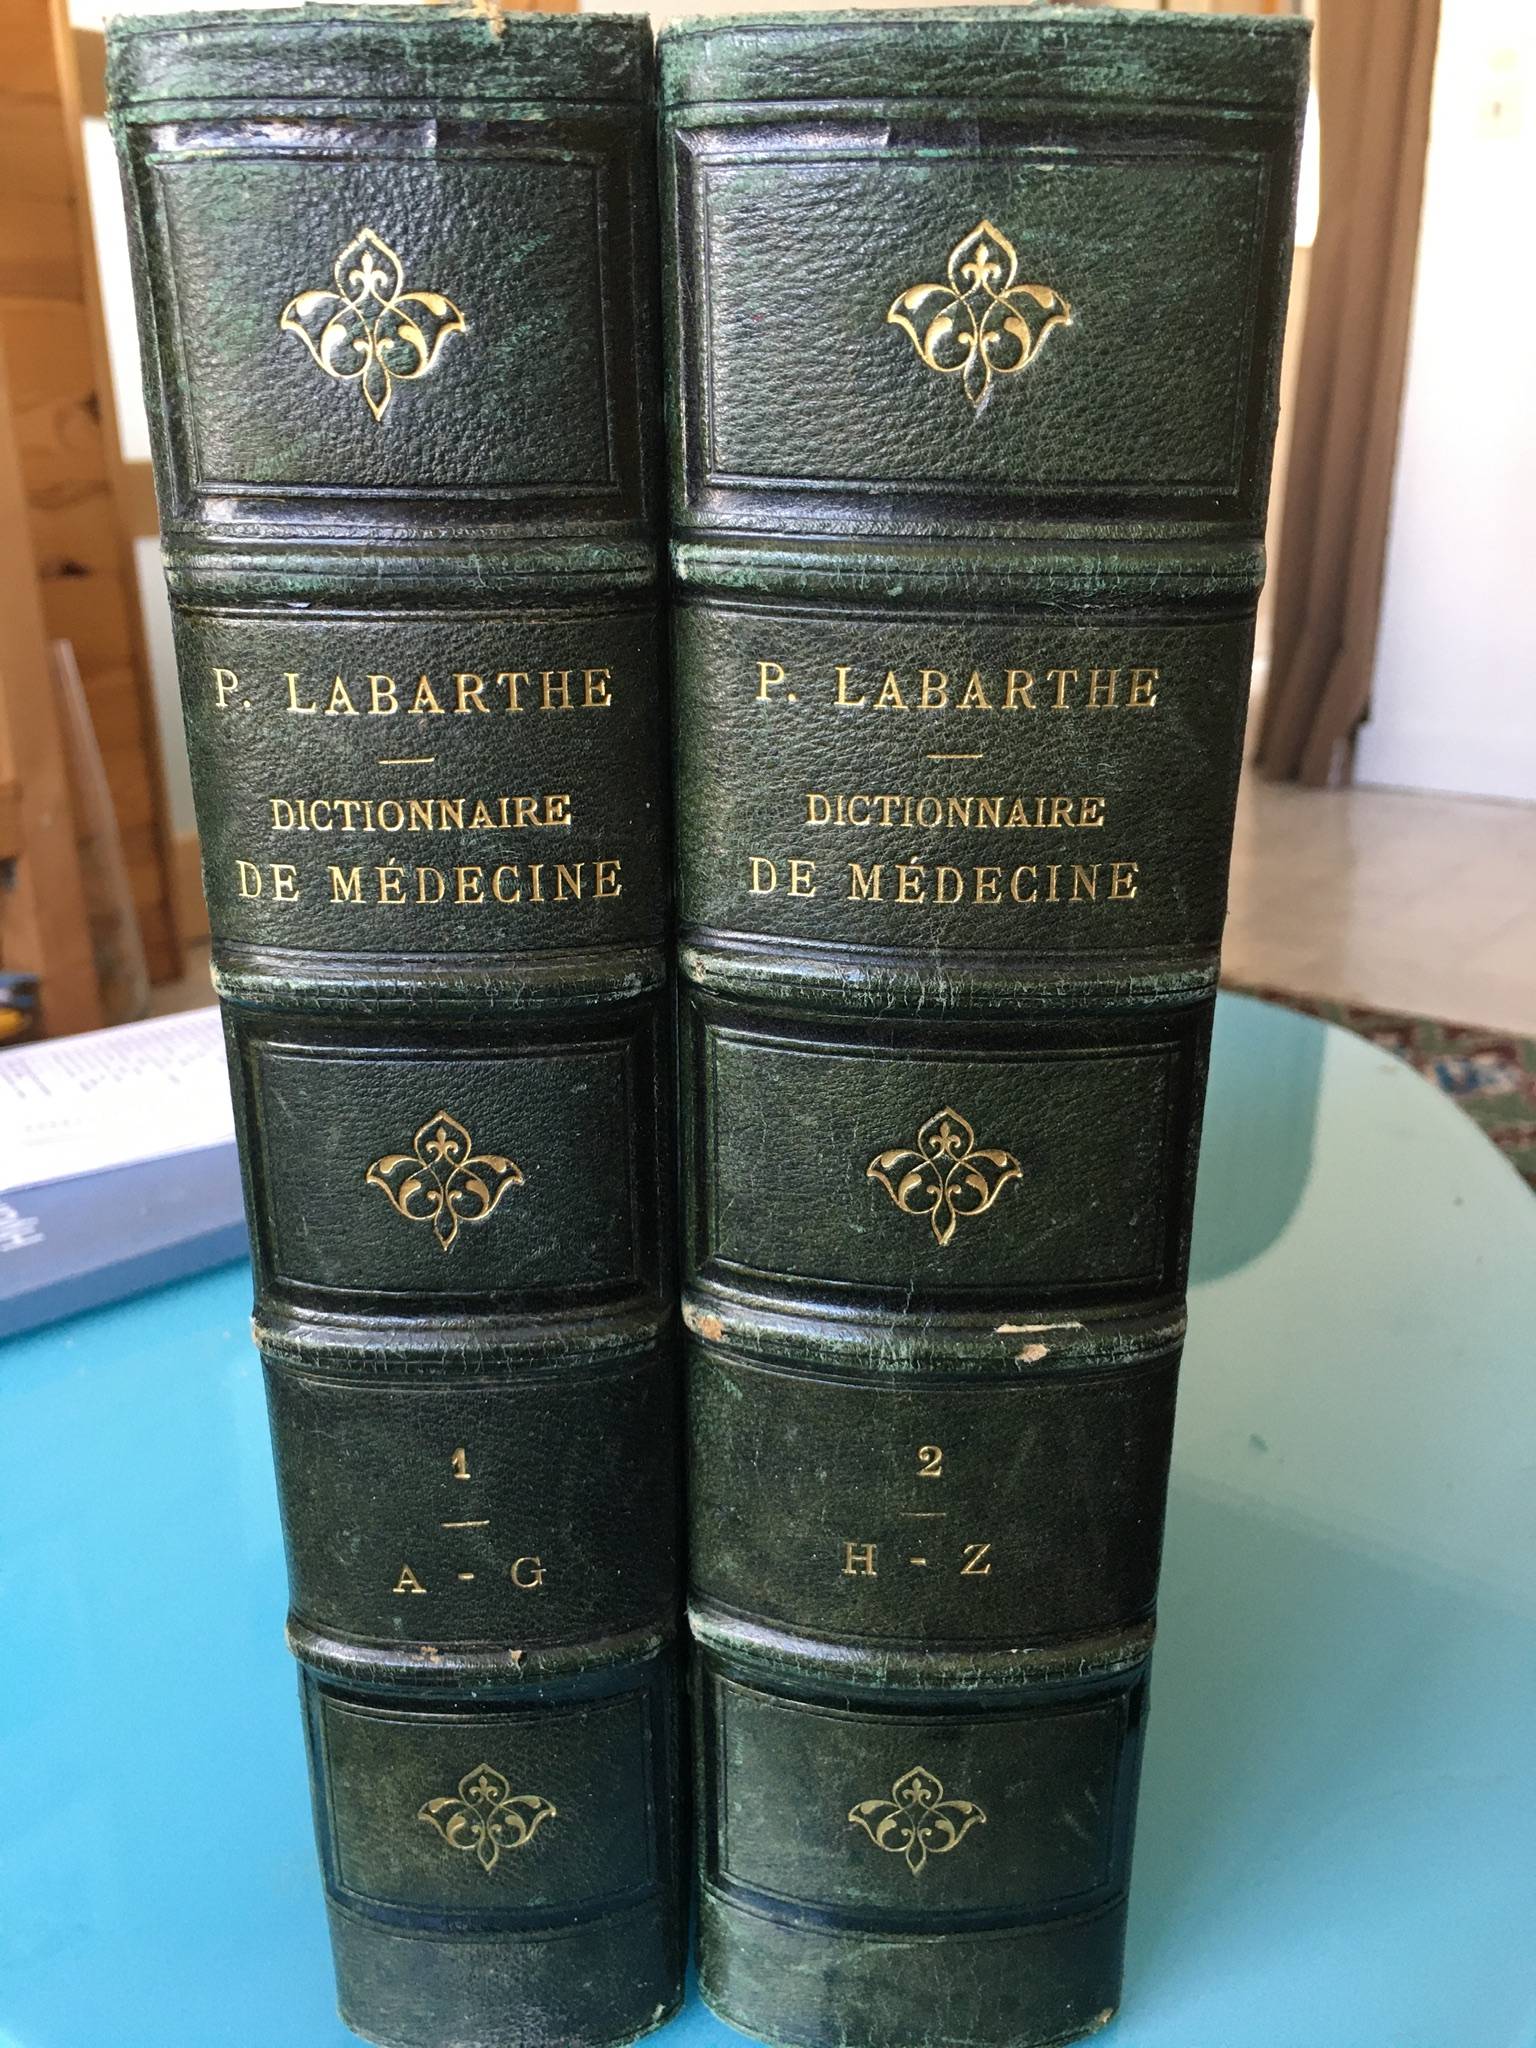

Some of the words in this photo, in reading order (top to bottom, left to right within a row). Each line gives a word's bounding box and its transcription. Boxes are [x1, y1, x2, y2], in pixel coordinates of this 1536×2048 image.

[213, 668, 251, 707] P.
[284, 668, 613, 715] LABARTHE
[756, 661, 797, 702] P.
[833, 666, 1160, 711] LABARTHE
[270, 794, 572, 833] DICTIONNAIRE
[805, 794, 1106, 829] DICTIONNAIRE
[236, 860, 300, 902] DE
[328, 857, 623, 905] MÉDECINE
[749, 856, 817, 898] DE
[848, 856, 1140, 905] MÉDECINE
[451, 1447, 471, 1480] 1
[917, 1444, 943, 1477] 2
[392, 1564, 427, 1593] A
[510, 1556, 547, 1590] G
[841, 1542, 878, 1577] H
[959, 1543, 992, 1577] Z
